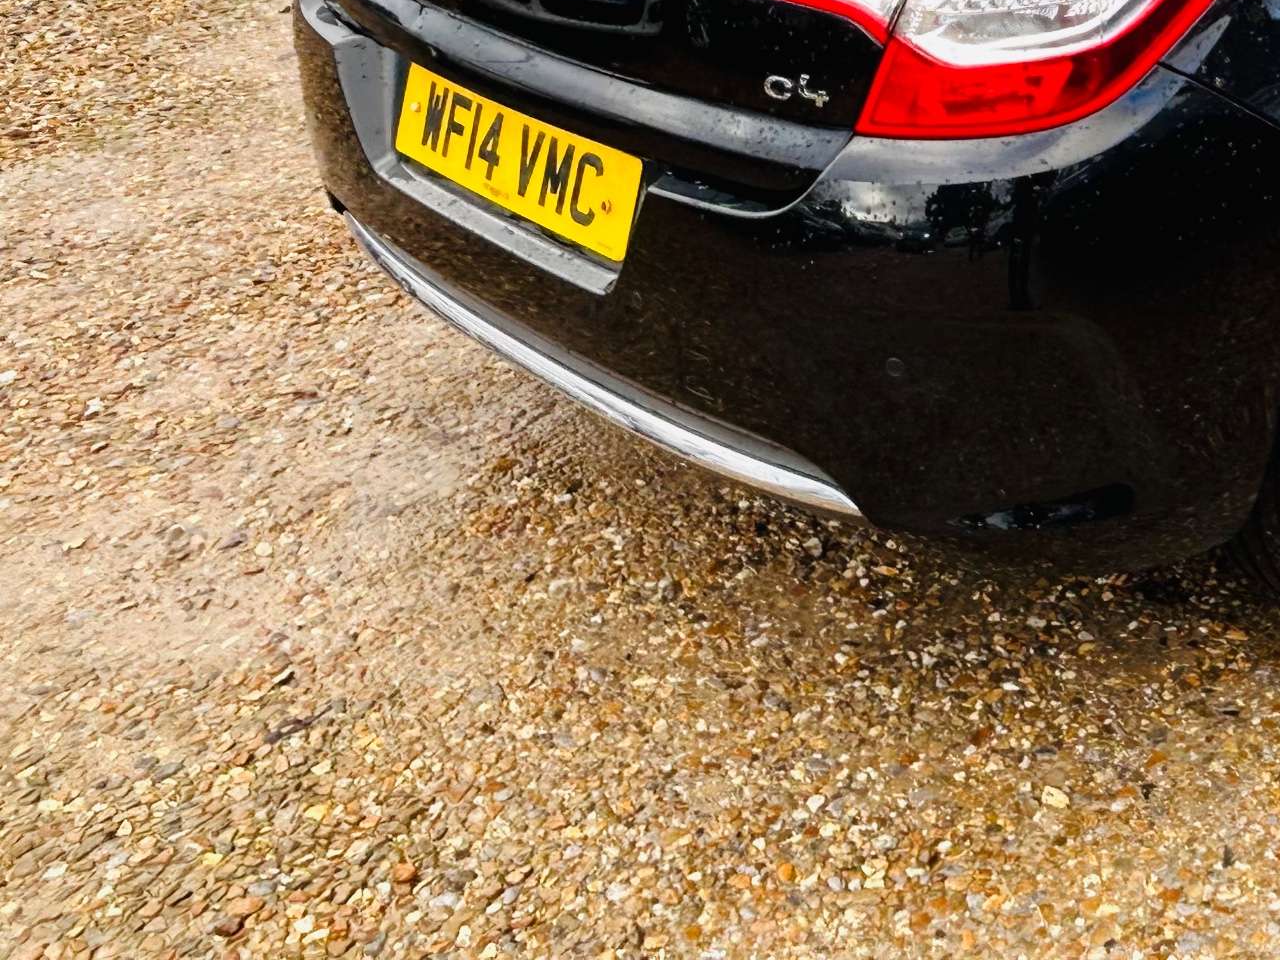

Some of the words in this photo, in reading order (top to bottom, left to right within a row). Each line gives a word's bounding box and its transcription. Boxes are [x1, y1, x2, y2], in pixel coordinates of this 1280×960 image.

[763, 73, 829, 108] C4
[421, 80, 505, 181] WF14
[517, 123, 604, 227] VMC
